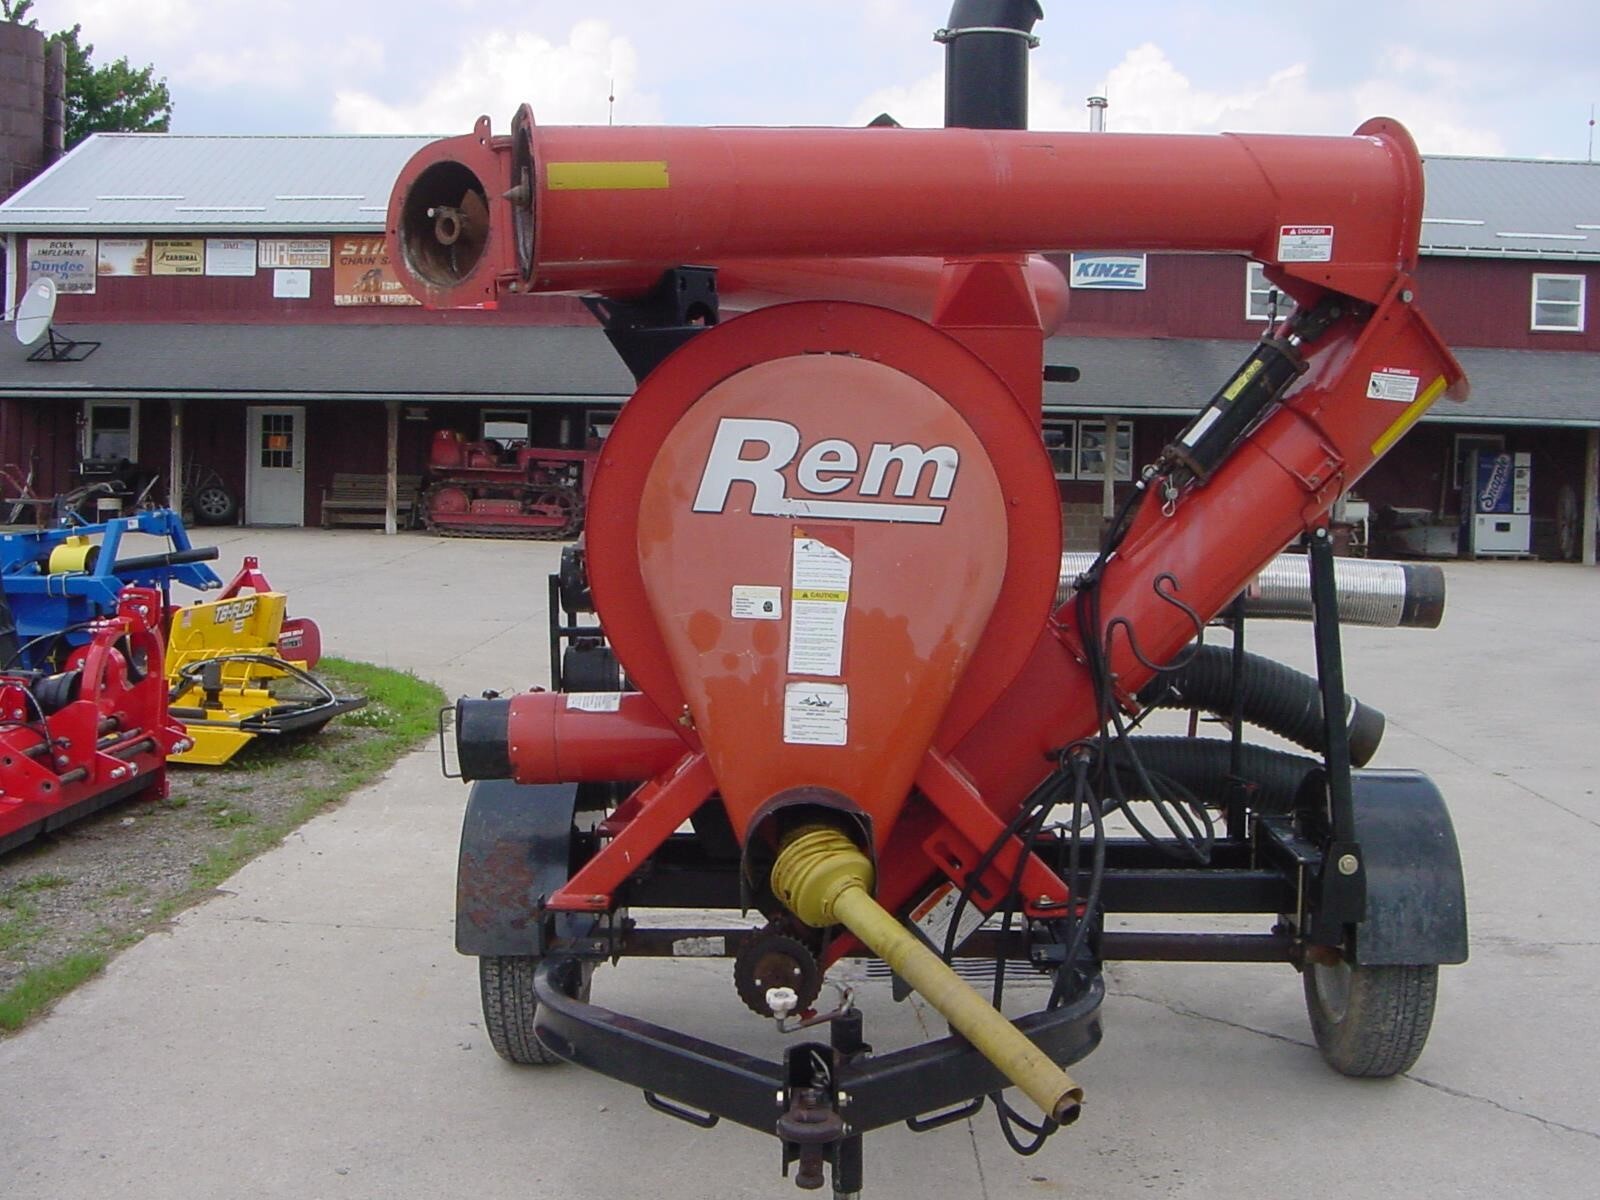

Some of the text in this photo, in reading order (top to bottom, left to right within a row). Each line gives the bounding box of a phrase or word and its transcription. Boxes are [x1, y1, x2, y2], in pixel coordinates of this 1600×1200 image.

[31, 260, 84, 274] Dundee
[340, 257, 376, 265] CHAIN
[1076, 263, 1140, 278] KINZE
[692, 417, 959, 514] Rem
[1480, 455, 1510, 511] Snapple
[810, 592, 840, 600] CAUTION
